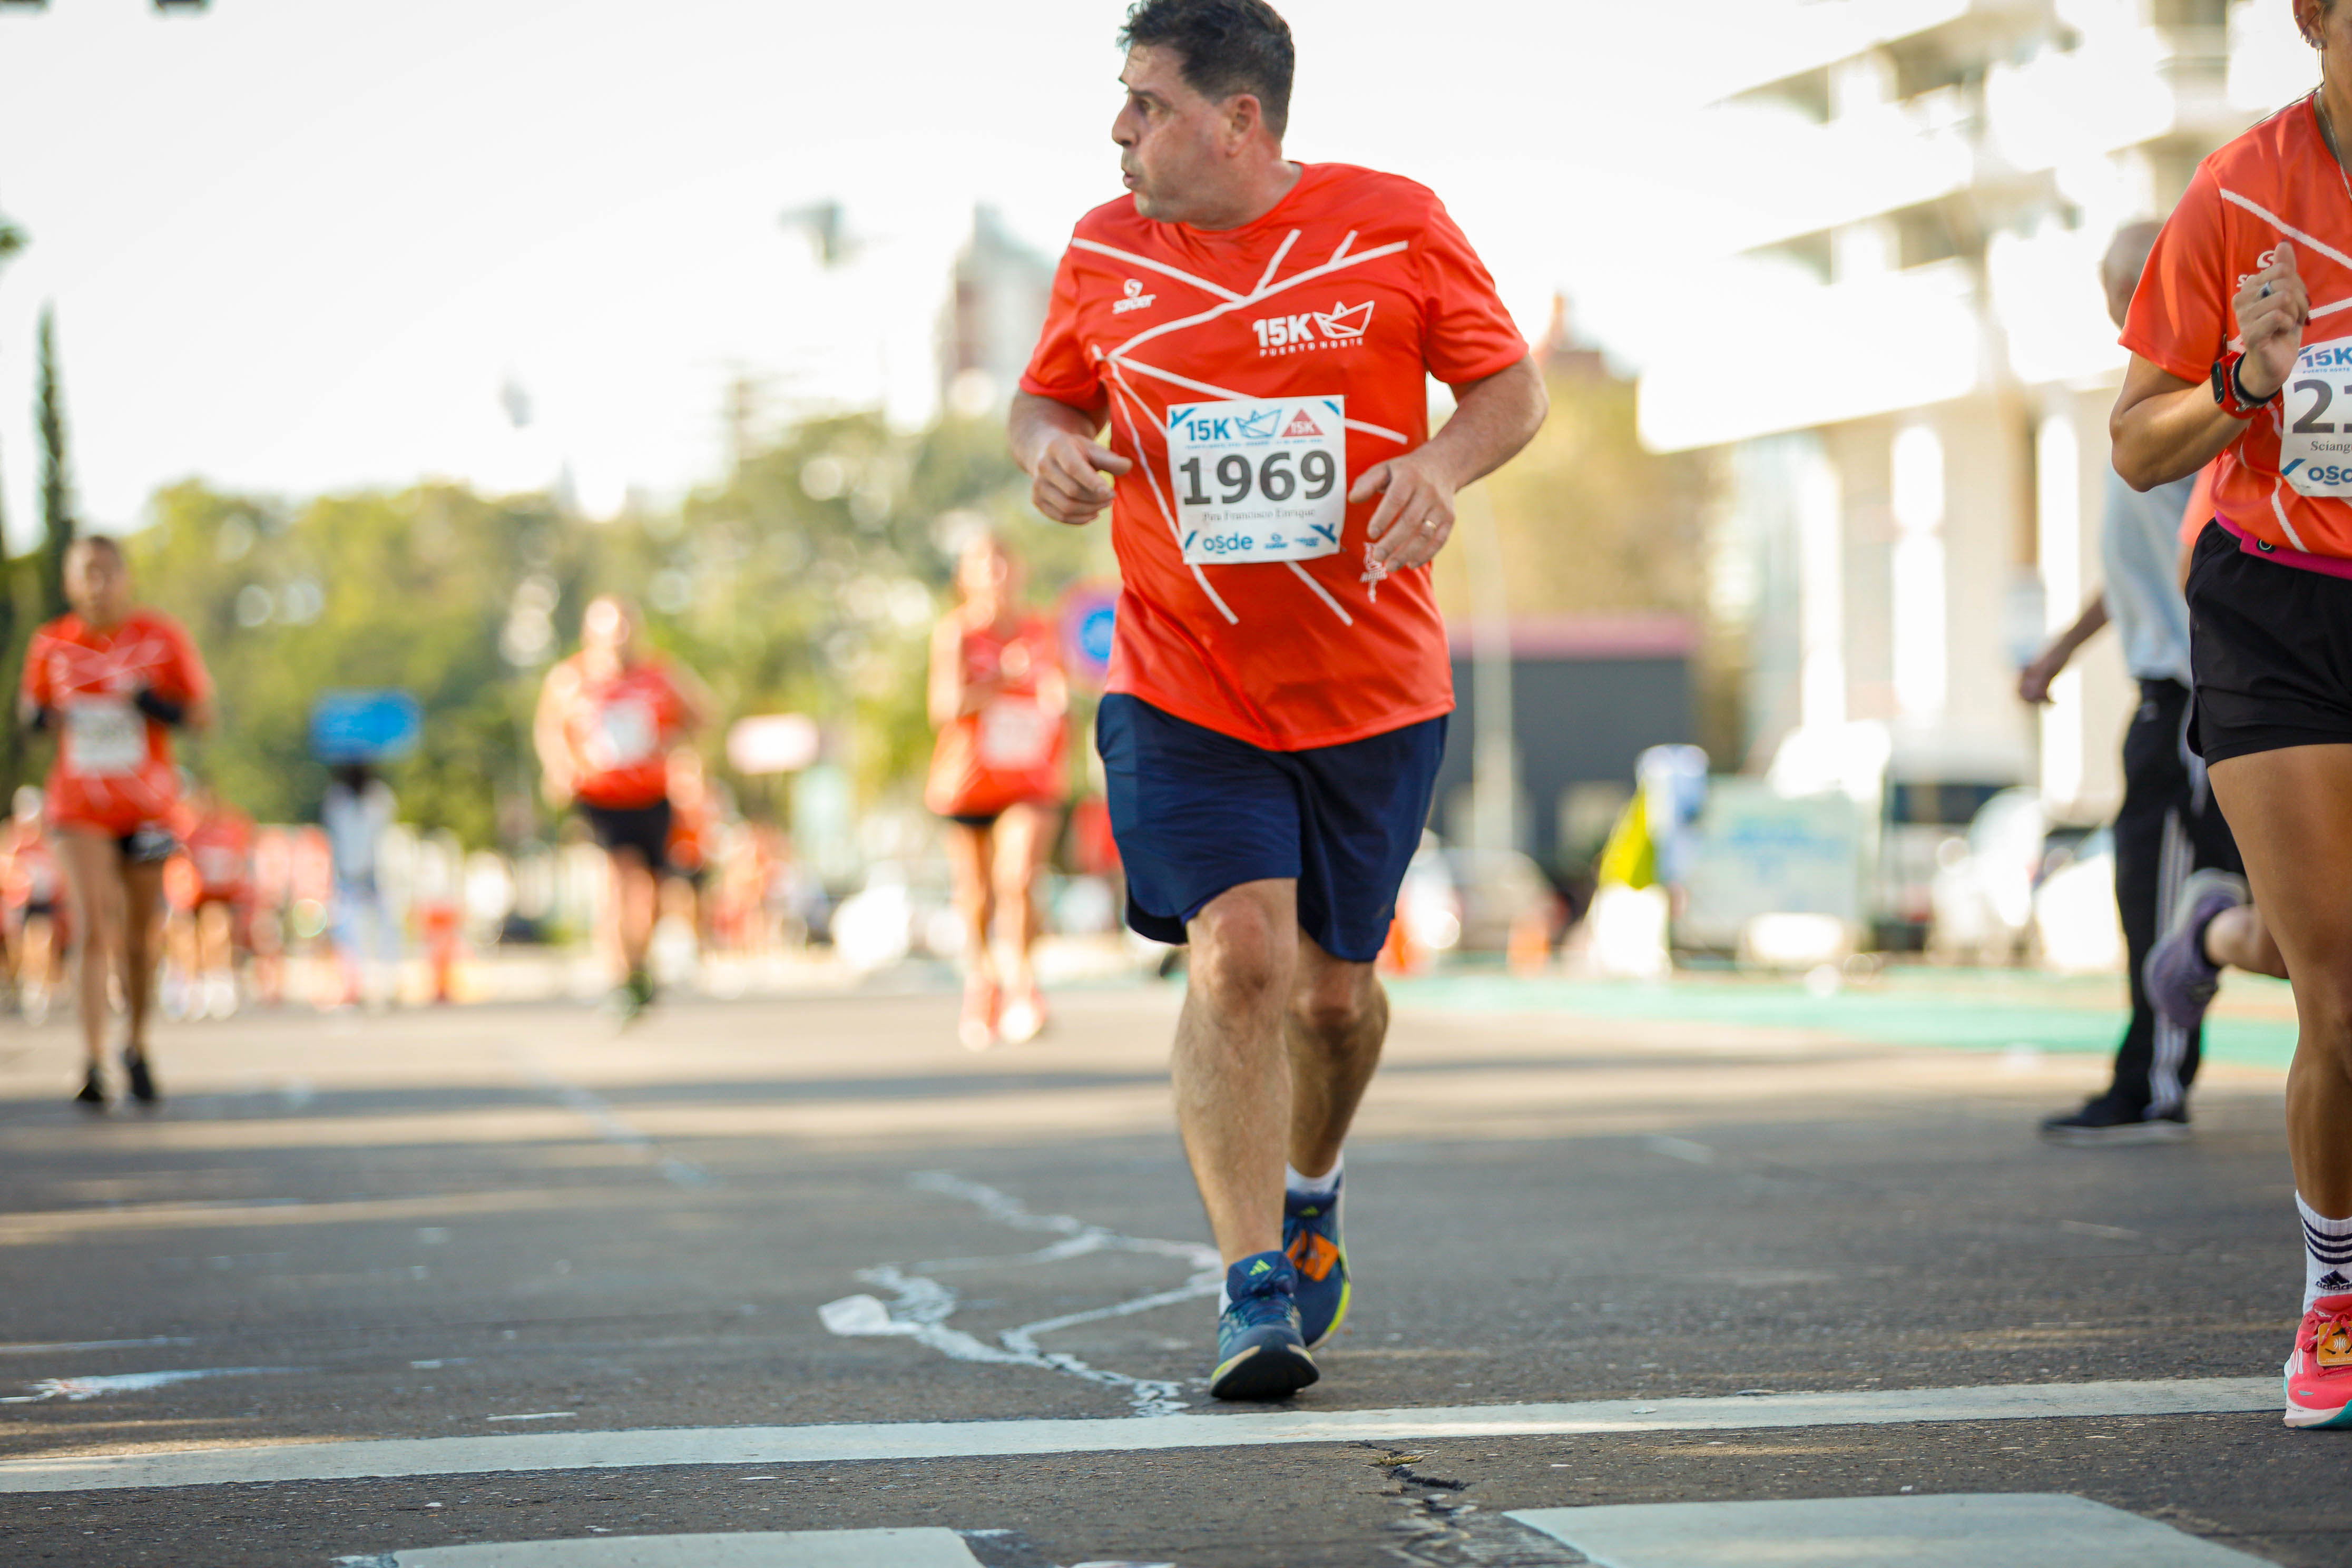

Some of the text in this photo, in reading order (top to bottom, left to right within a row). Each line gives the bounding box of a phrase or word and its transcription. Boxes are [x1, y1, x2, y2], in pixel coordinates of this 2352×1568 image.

[1253, 312, 1315, 348] 15K
[1259, 337, 1364, 358] PUERTO NORTE
[2301, 347, 2352, 368] 15K
[1185, 418, 1231, 442] 15K
[2310, 440, 2352, 454] Sciang
[1180, 450, 1336, 505] 1969
[1203, 532, 1253, 553] osde
